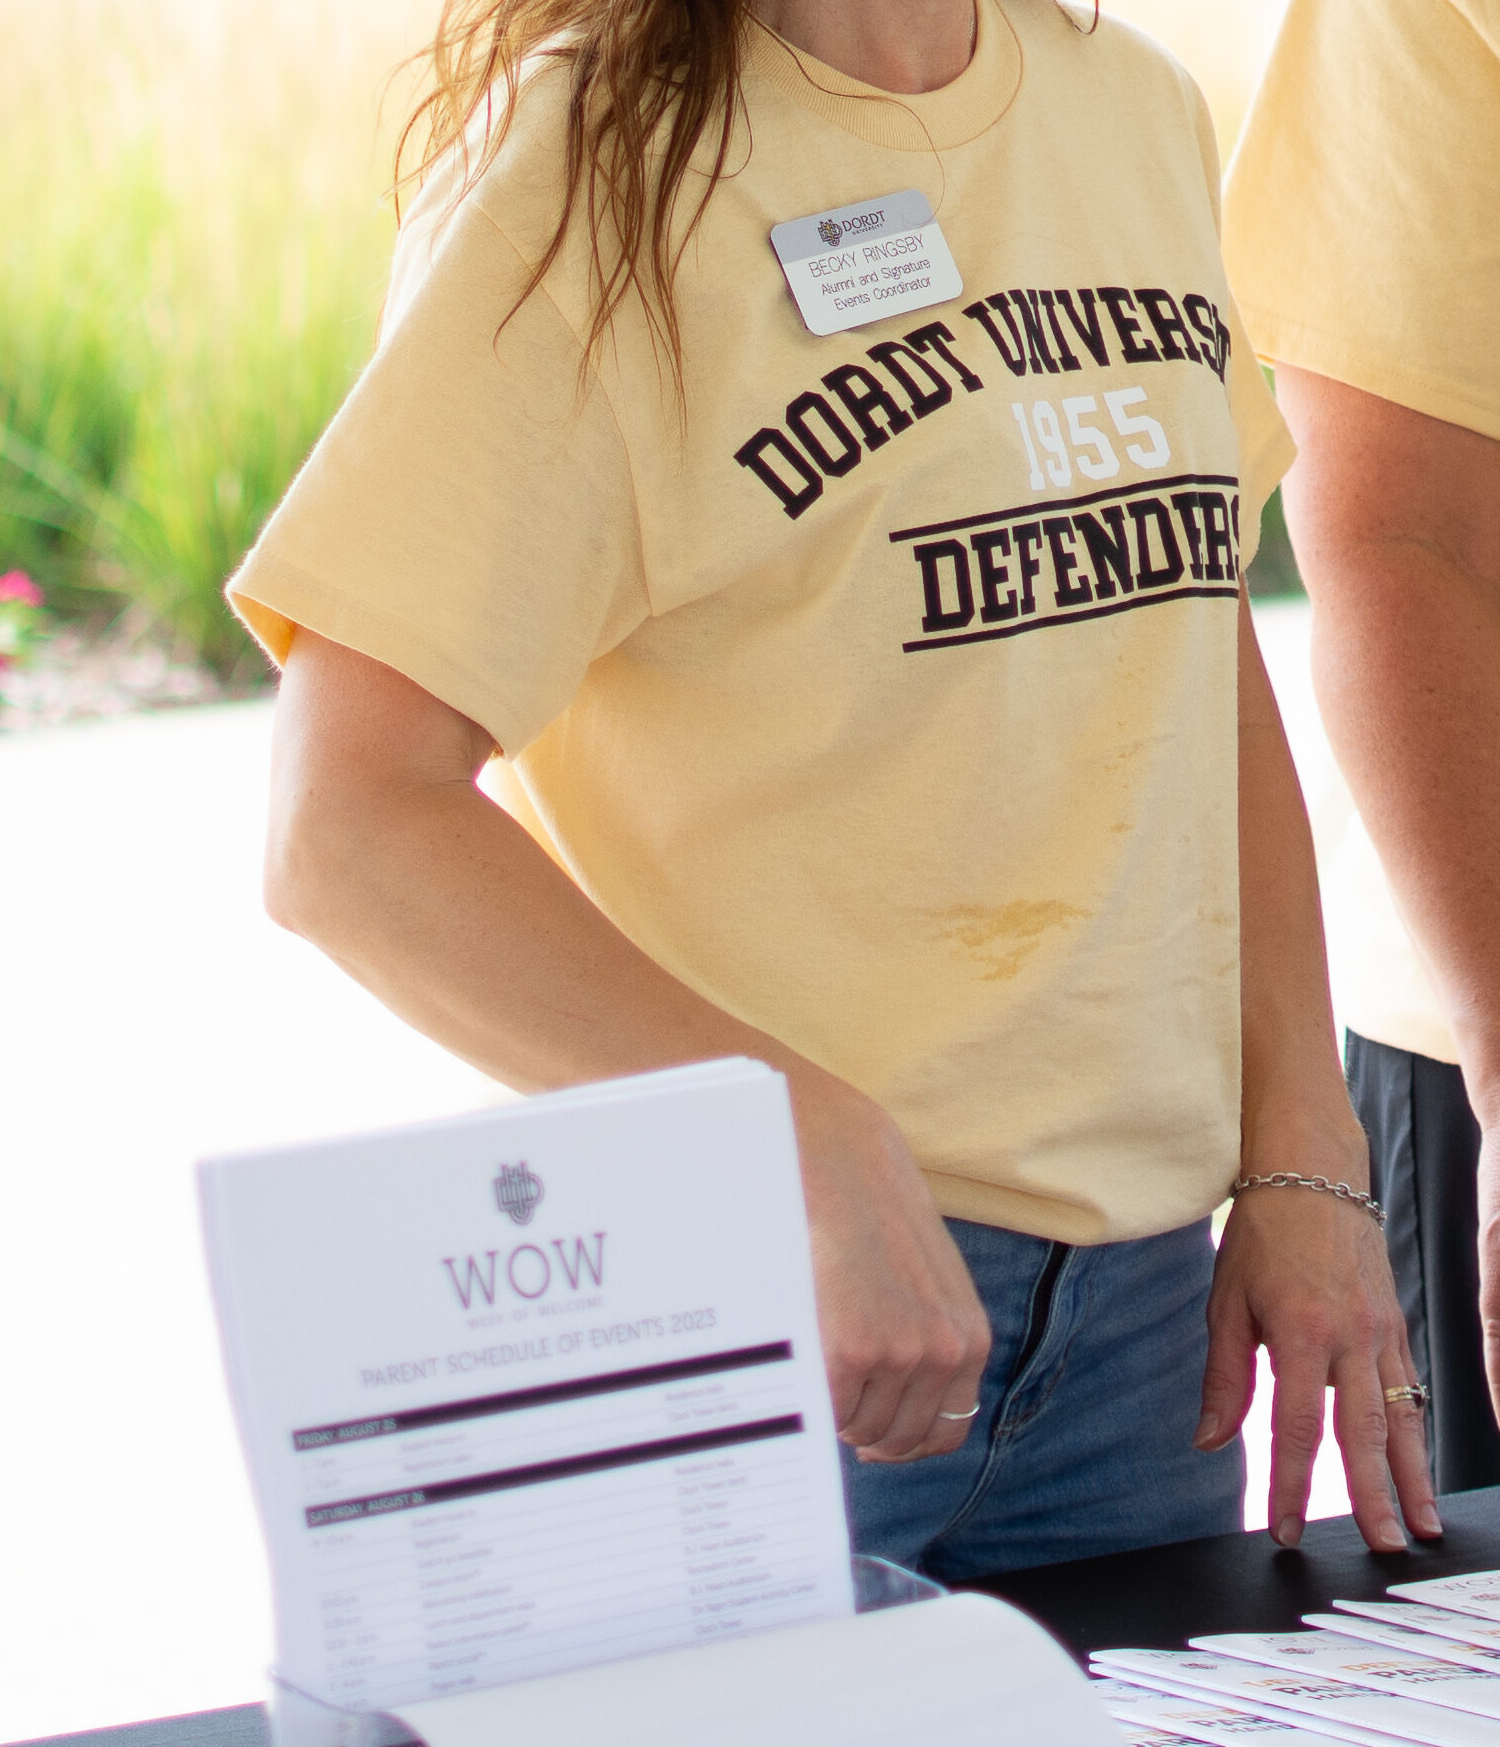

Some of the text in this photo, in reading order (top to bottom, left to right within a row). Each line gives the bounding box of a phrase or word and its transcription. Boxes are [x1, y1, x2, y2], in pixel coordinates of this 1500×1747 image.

[808, 234, 924, 278] BECKY RINGSBY
[841, 210, 886, 233] DORDT
[821, 258, 931, 296] Alumni and Signature
[834, 276, 931, 311] Events Coordinator
[733, 321, 984, 520] DORDT
[1012, 387, 1171, 491] 1955
[914, 491, 1239, 633] DEFENDER
[442, 1231, 607, 1309] WOW
[361, 1357, 439, 1388] PARENT
[448, 1337, 549, 1374] SCHEDULE
[559, 1331, 584, 1354] OF
[591, 1317, 665, 1349] EVENTS
